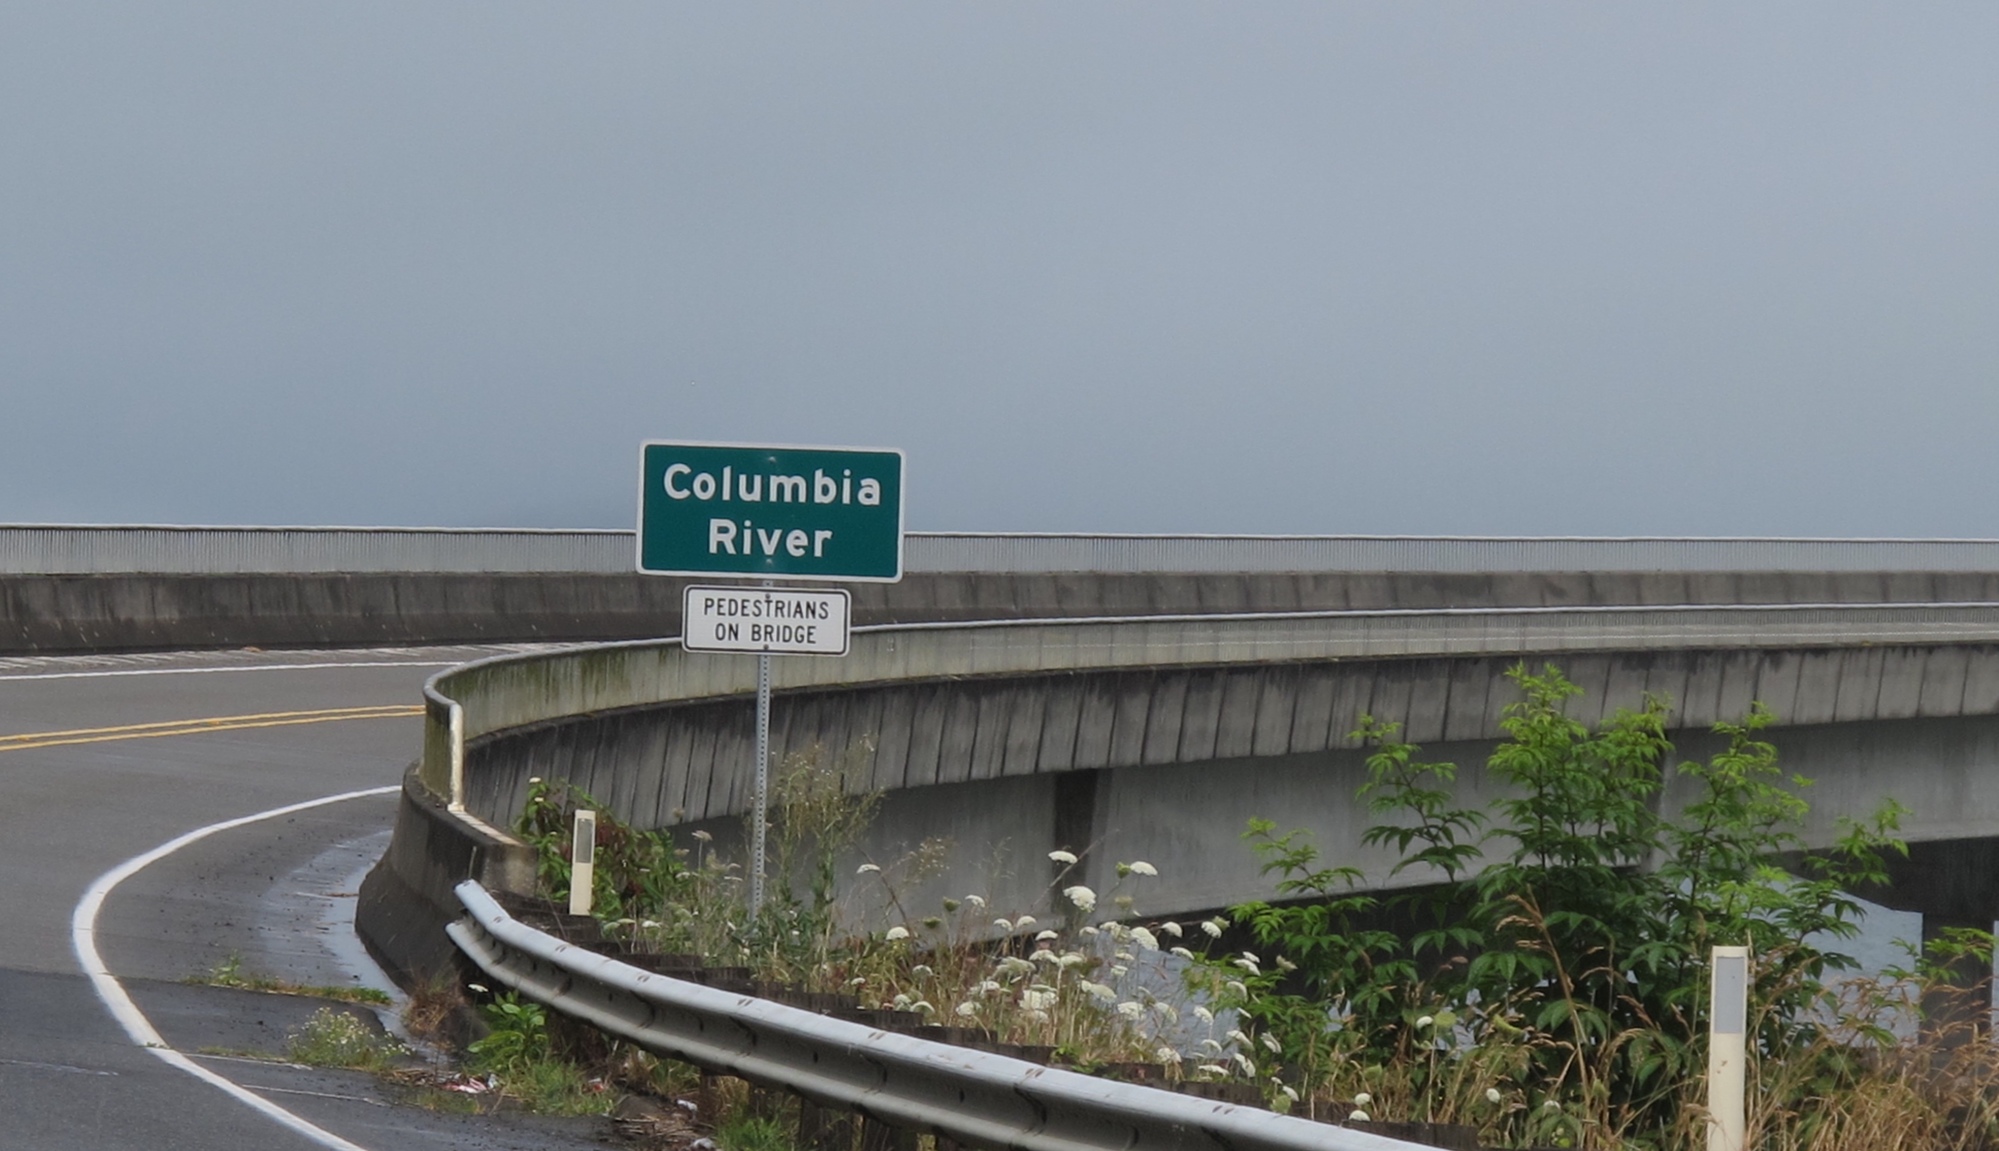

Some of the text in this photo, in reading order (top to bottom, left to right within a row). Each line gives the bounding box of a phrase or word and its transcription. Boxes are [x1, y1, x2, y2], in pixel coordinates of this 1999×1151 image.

[664, 463, 881, 506] Columbia
[708, 518, 833, 557] River
[704, 597, 829, 620] PEDESTRIANS
[715, 622, 817, 645] ON BRIDGE
